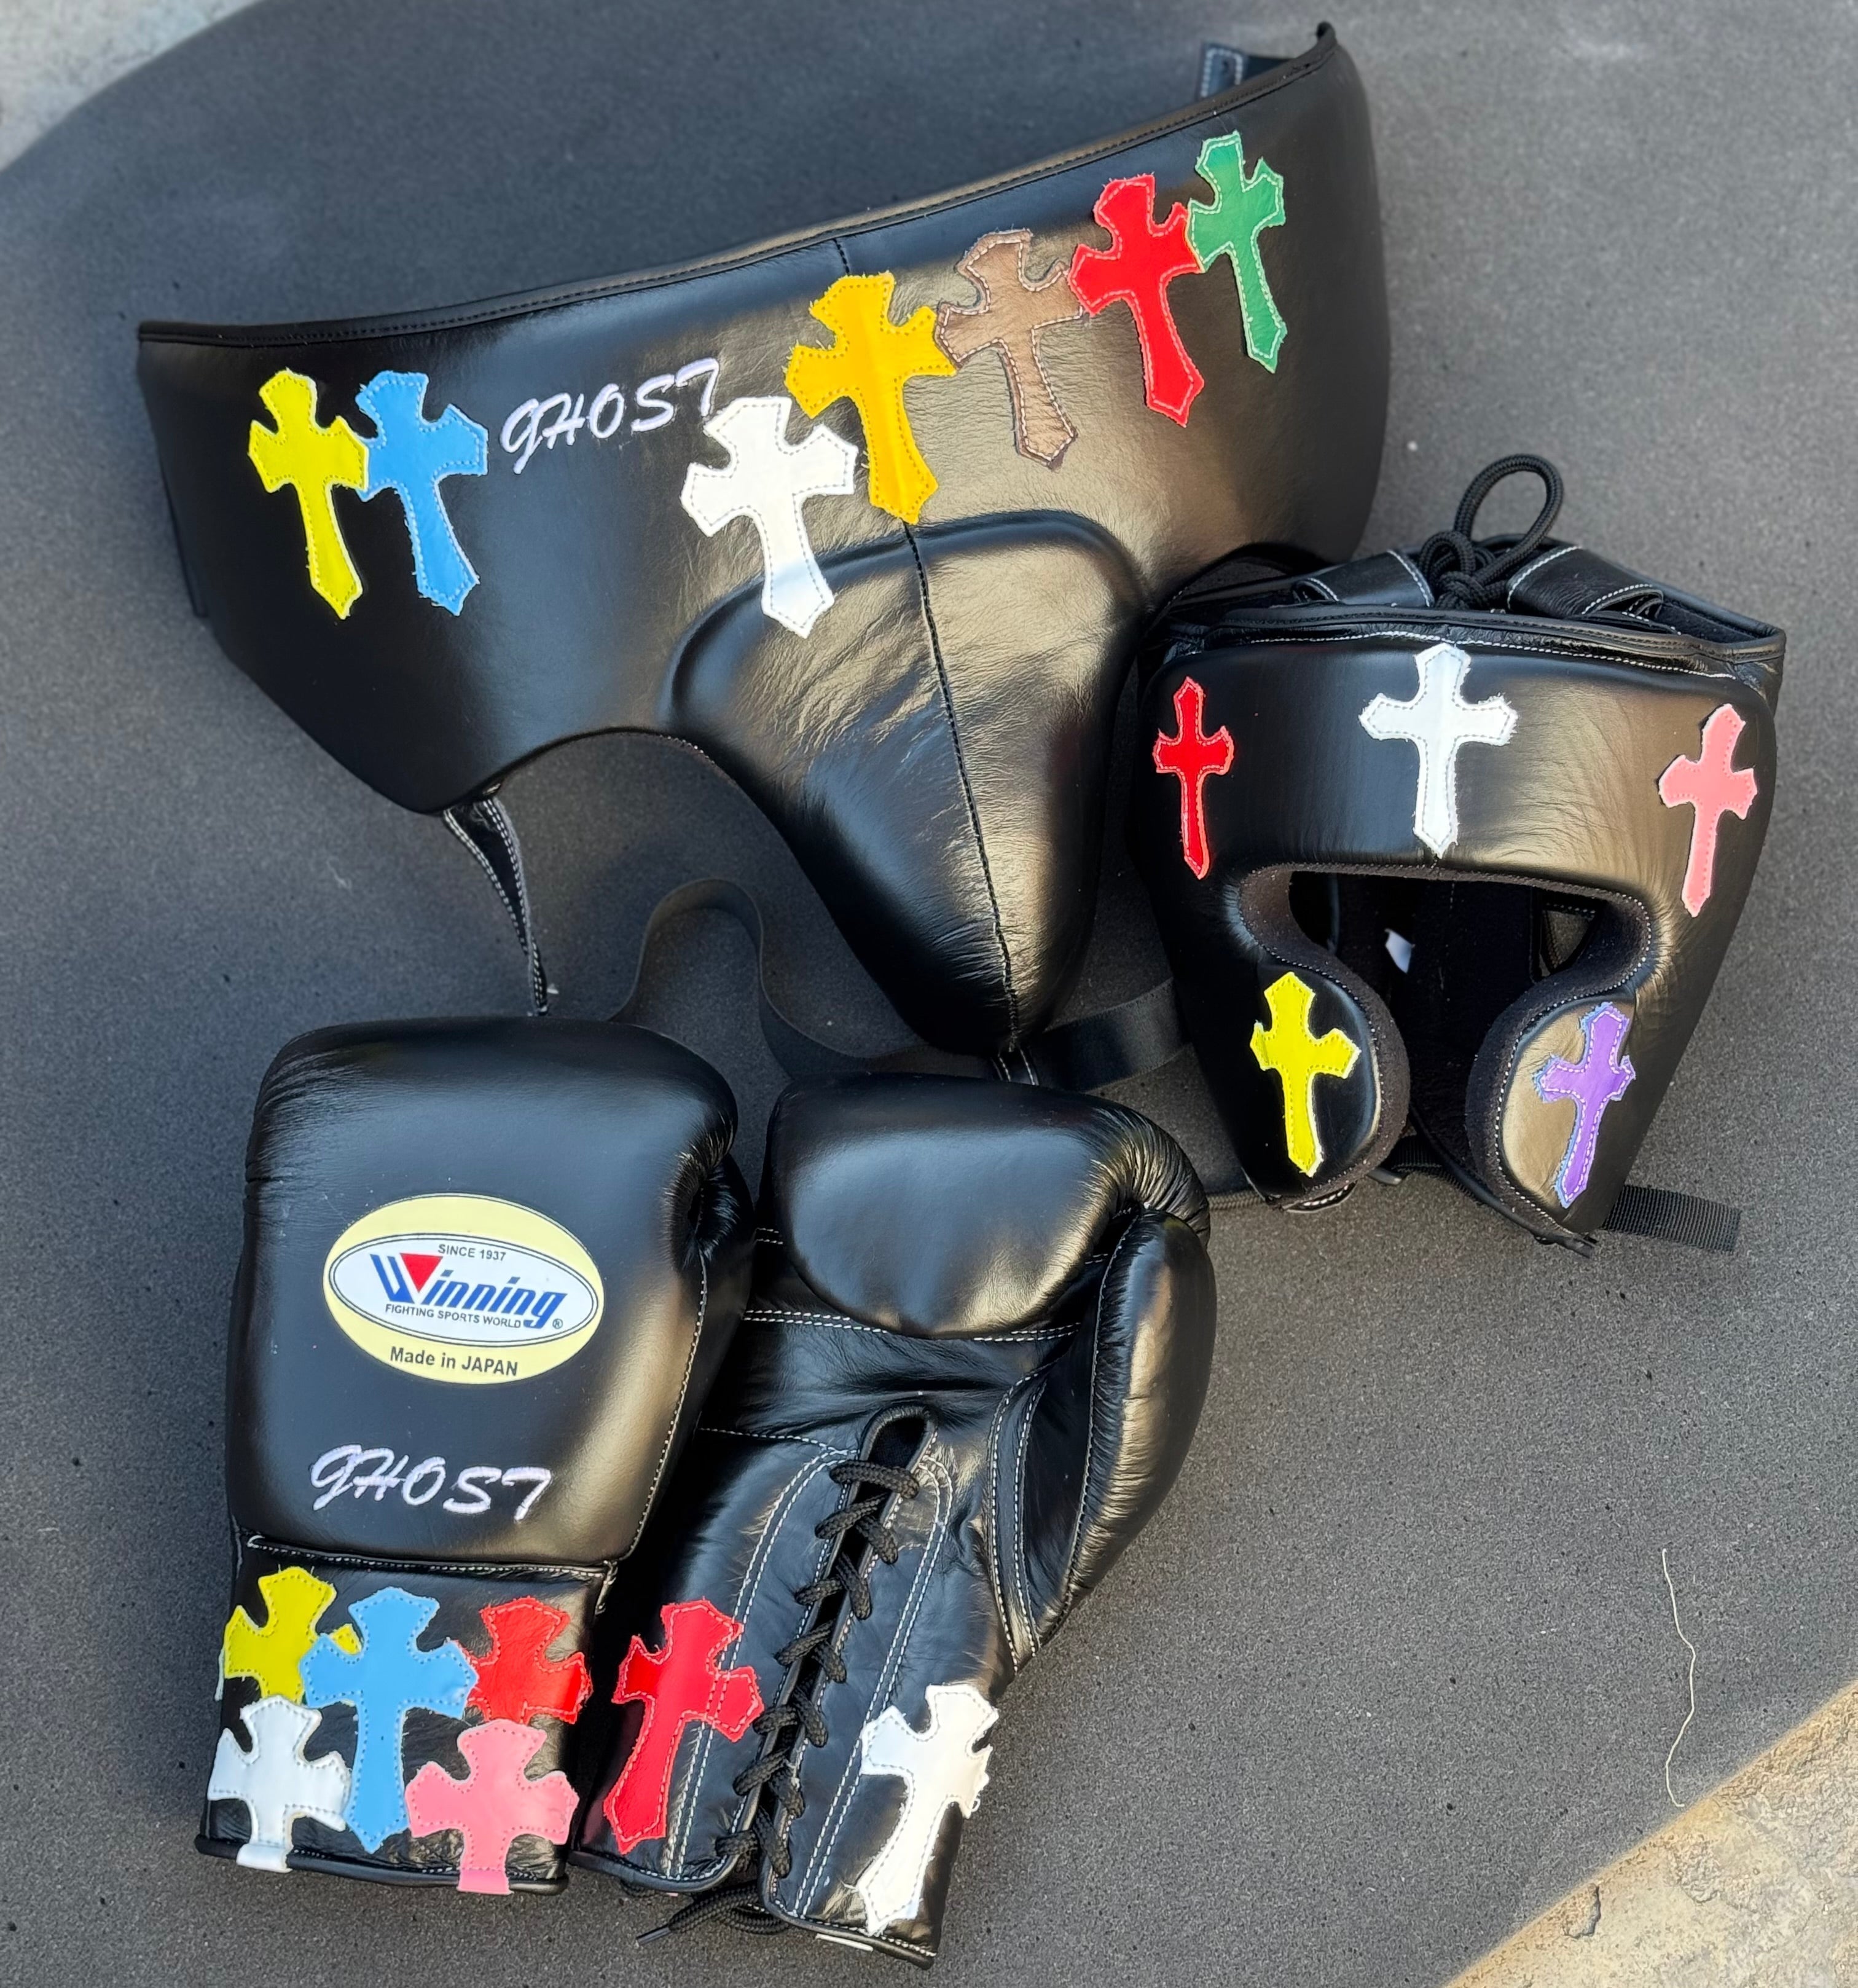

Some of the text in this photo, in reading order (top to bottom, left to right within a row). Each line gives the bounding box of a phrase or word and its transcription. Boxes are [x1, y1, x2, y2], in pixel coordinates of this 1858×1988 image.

[437, 1243, 506, 1262] SINCE 1937
[370, 1252, 568, 1329] Winning
[385, 1303, 521, 1329] FIGHTING SPORTS WORLD
[390, 1346, 518, 1377] Made in JAPAN
